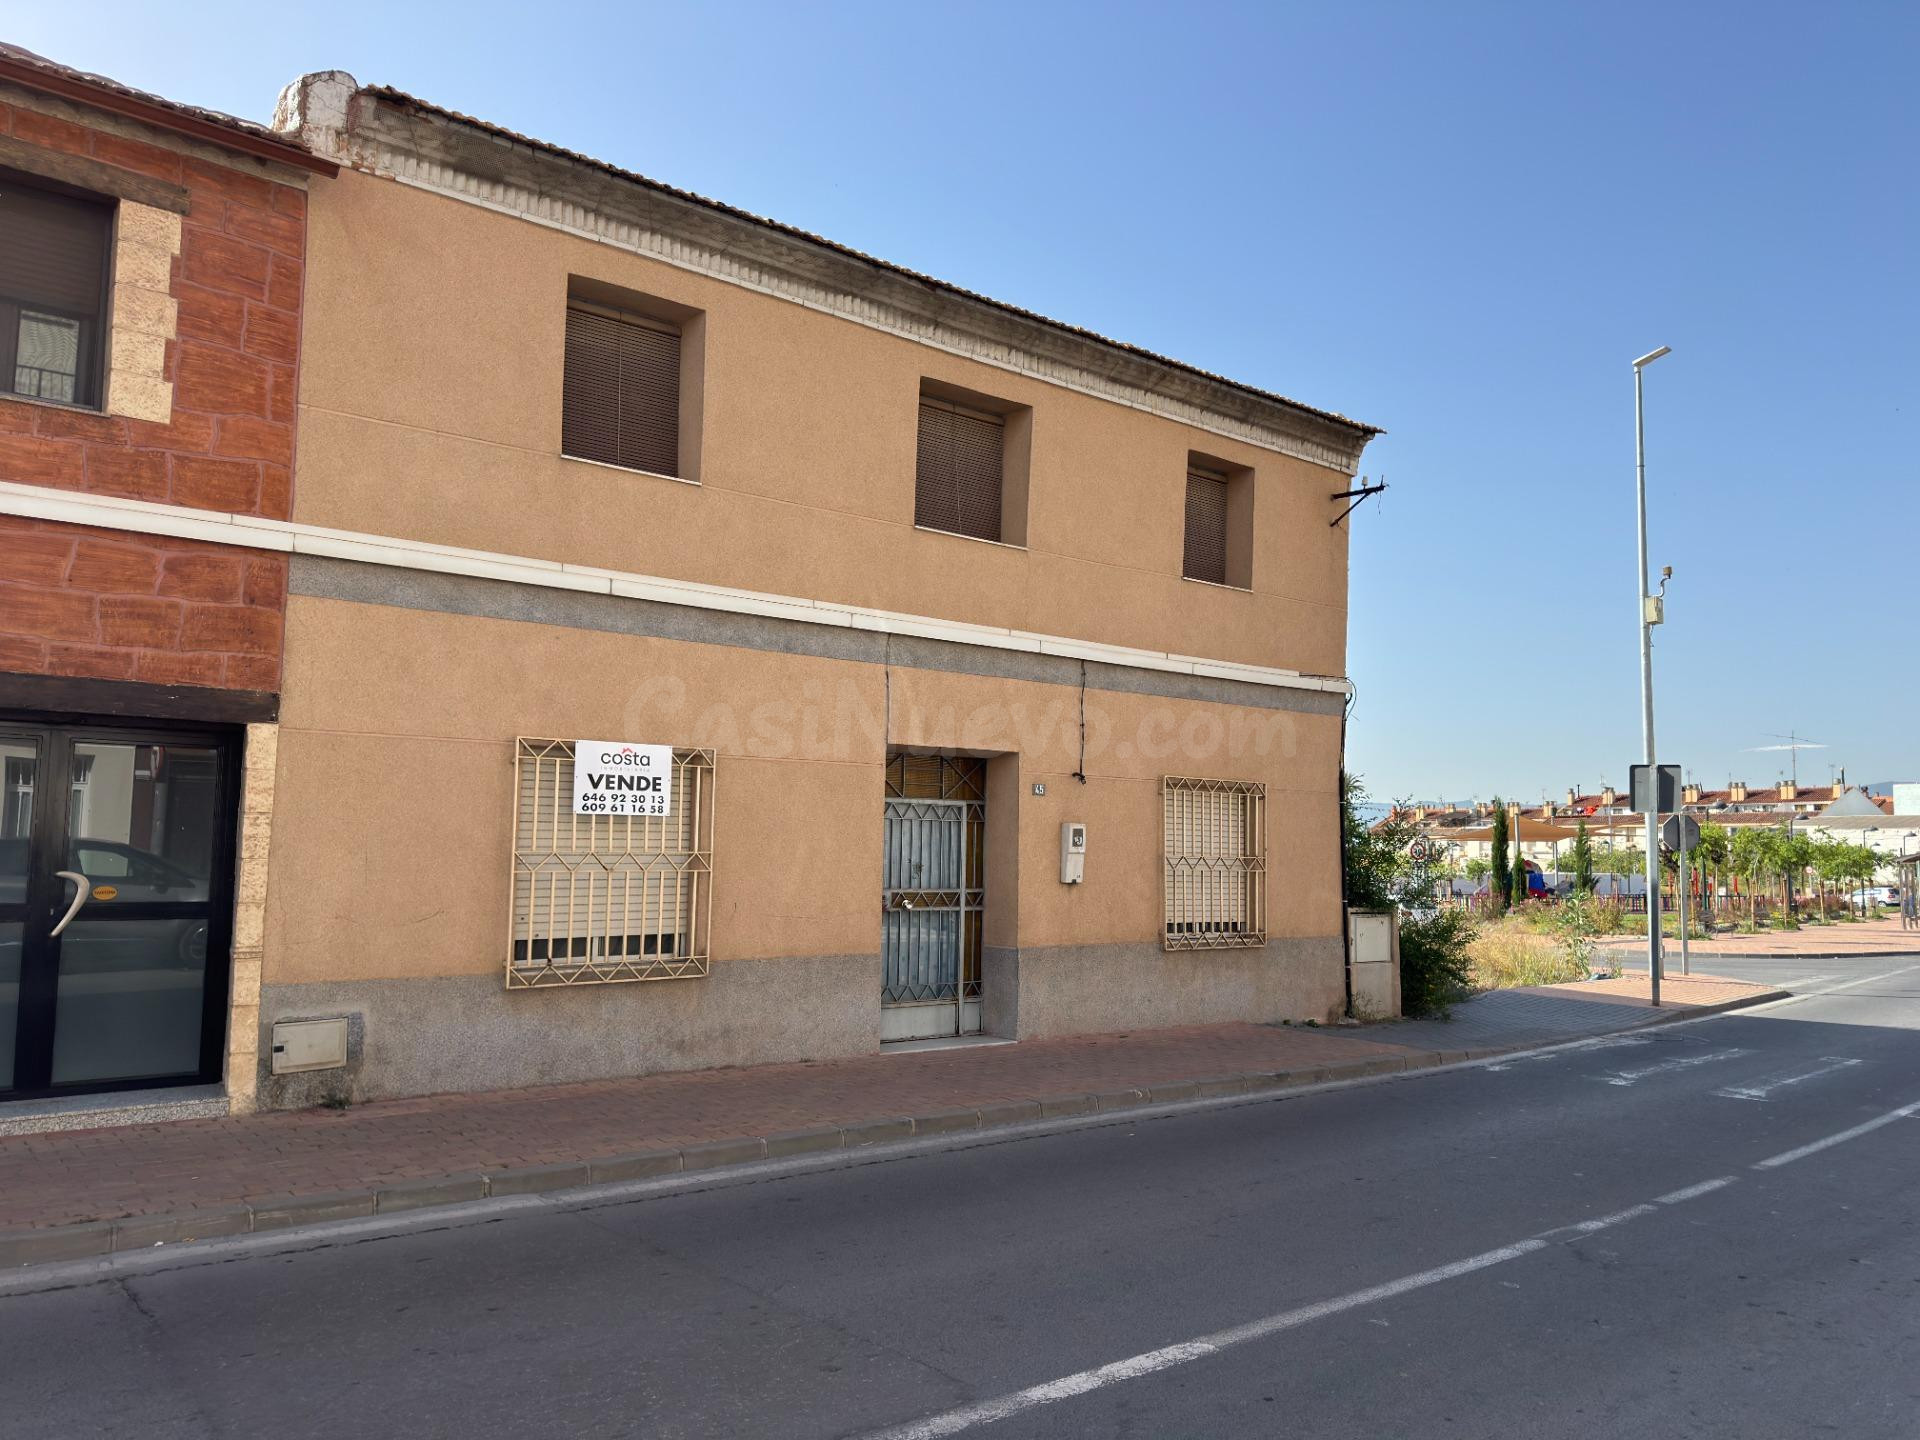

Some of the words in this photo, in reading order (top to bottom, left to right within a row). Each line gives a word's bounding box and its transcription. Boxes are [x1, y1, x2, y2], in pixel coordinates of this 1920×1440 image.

[601, 752, 650, 766] costa
[587, 773, 662, 792] VENDE
[582, 793, 606, 802] 646
[611, 794, 626, 803] 92
[631, 795, 646, 803] 30
[651, 796, 664, 804] 13
[582, 803, 606, 812] 609
[610, 804, 625, 812] 61
[632, 805, 645, 813] 16
[650, 806, 664, 814] 58
